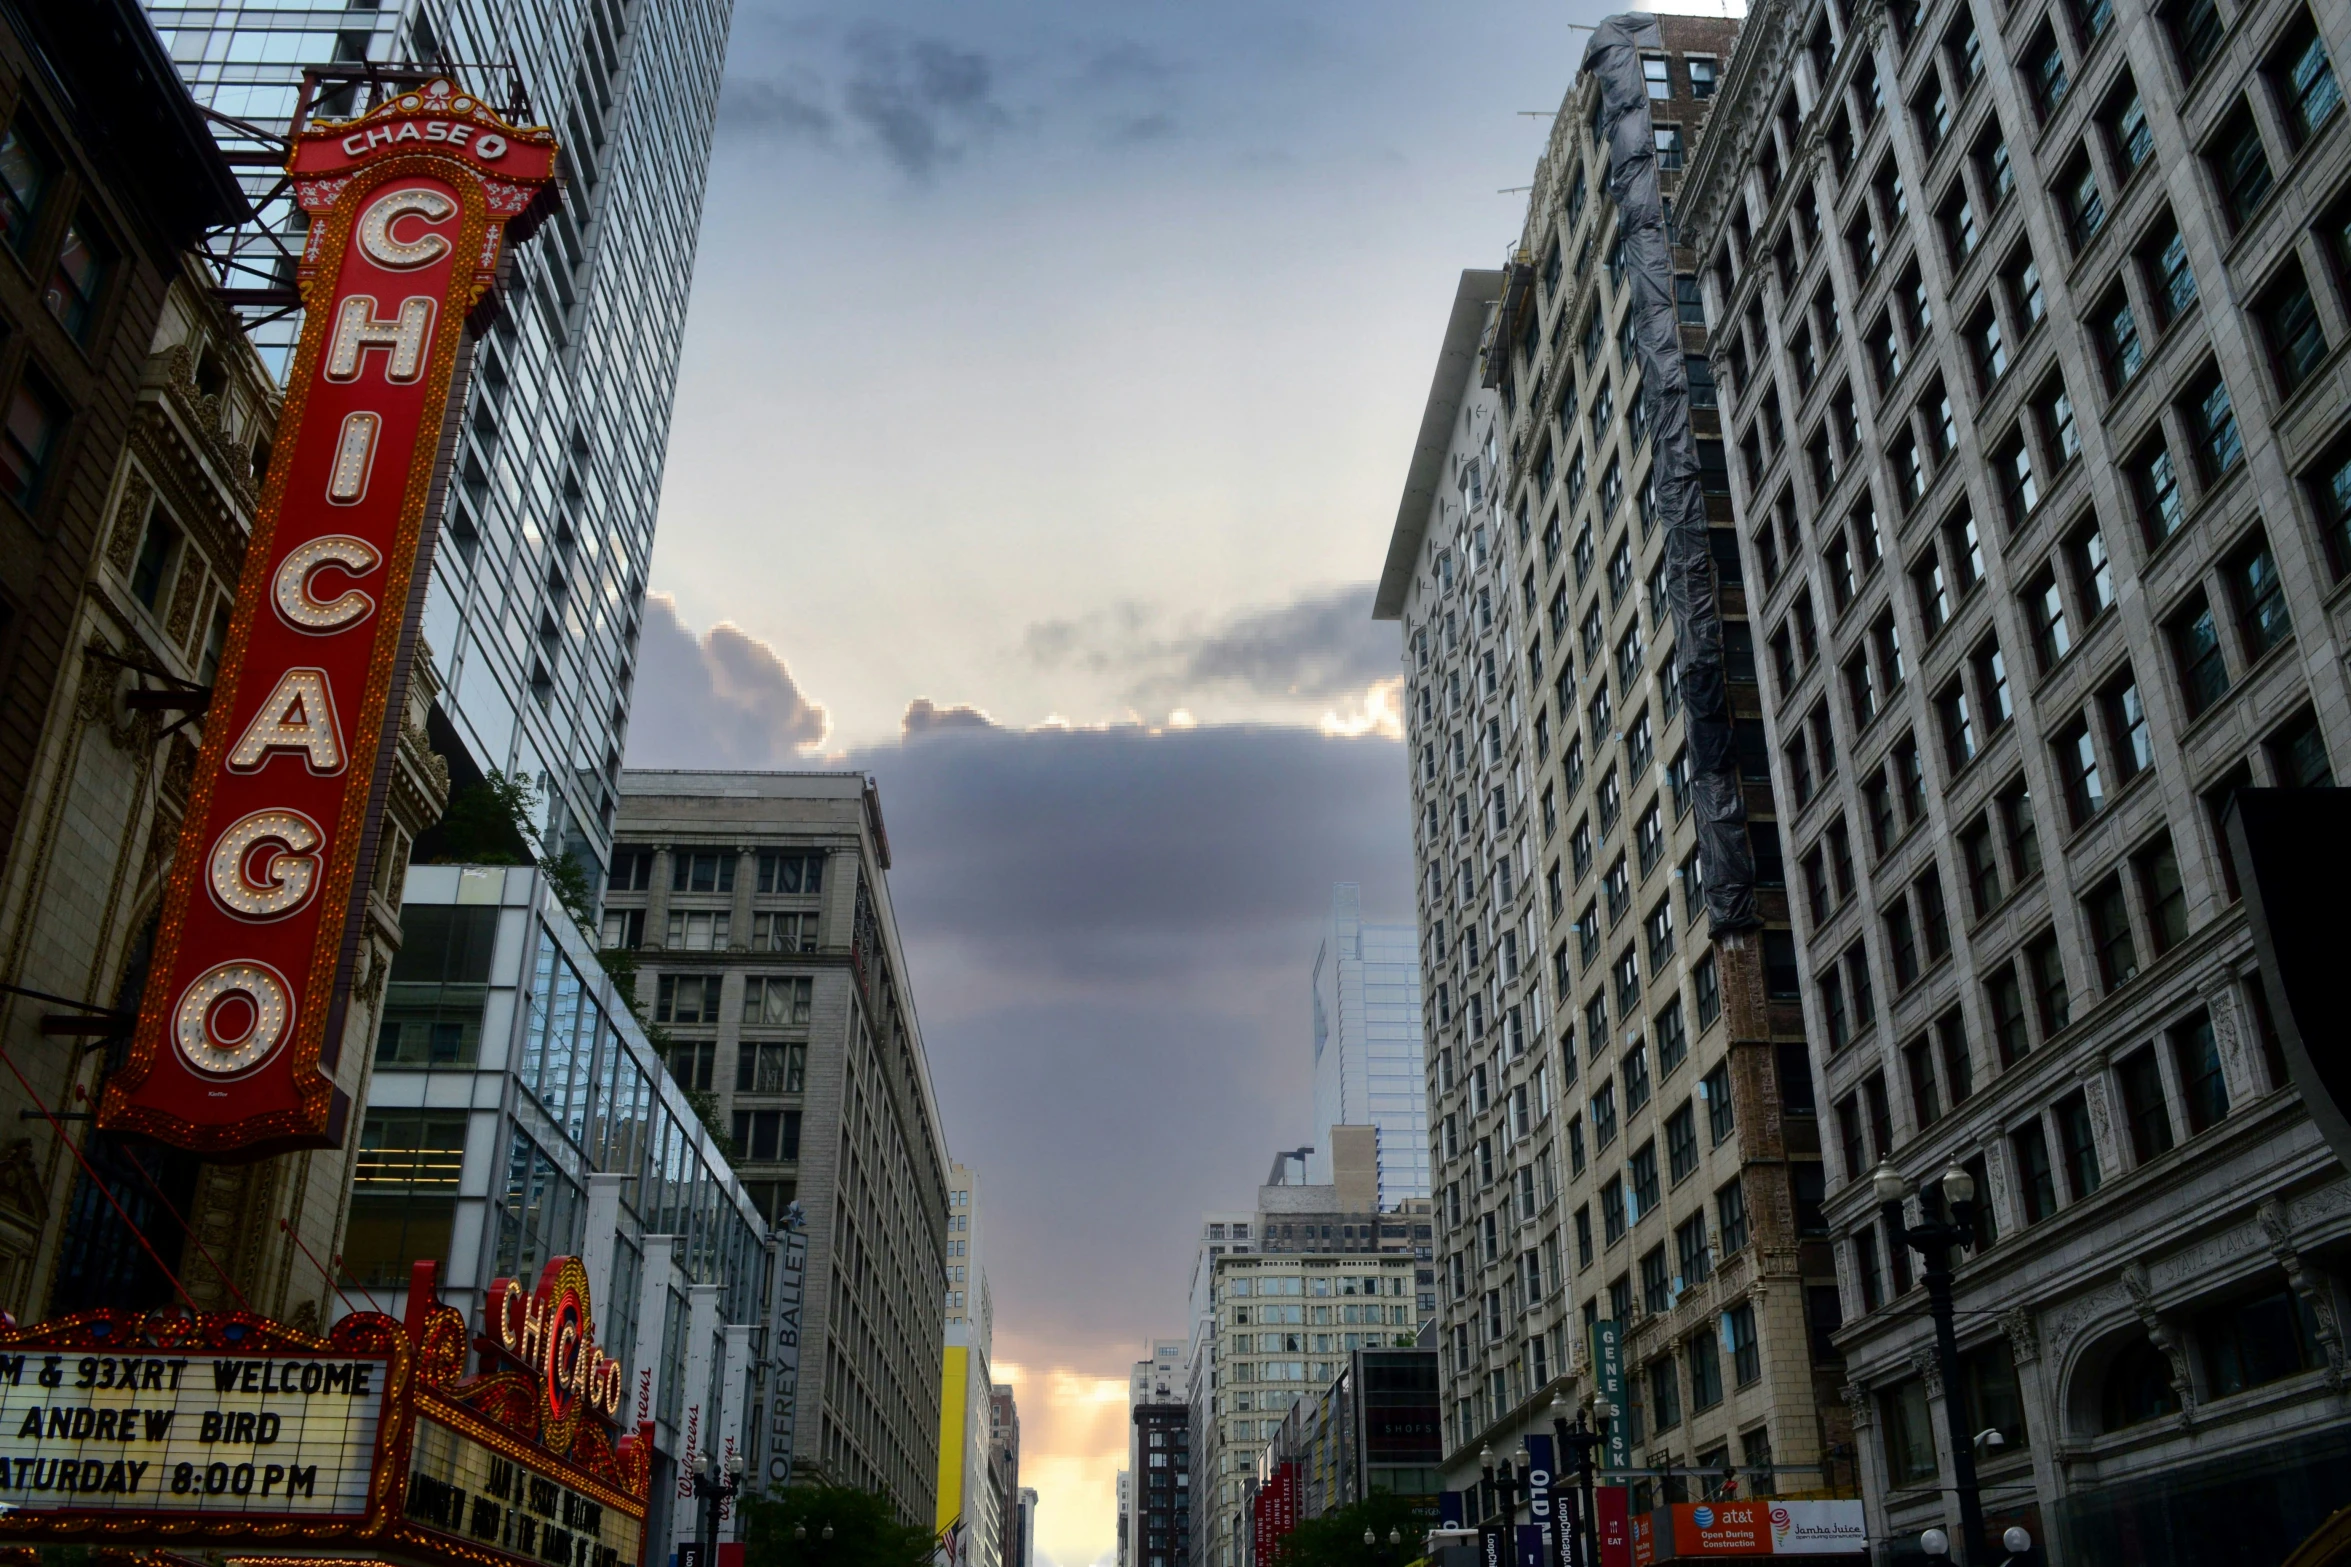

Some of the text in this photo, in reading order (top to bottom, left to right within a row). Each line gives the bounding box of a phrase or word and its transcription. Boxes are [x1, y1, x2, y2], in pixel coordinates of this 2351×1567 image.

[341, 120, 475, 158] CHASE
[170, 188, 458, 1083] CHICAGO
[501, 1275, 622, 1417] CHICAGO
[768, 1234, 805, 1482] OFFREY BALLET
[1602, 1331, 1618, 1392] GENE
[39, 1355, 63, 1389] &
[75, 1356, 188, 1391] 93XRT
[213, 1359, 374, 1396] WELCOME
[18, 1405, 281, 1445] ANDREW BIRD
[678, 1404, 699, 1499] Walgreens
[717, 1435, 734, 1521] Wagreens
[1283, 1478, 1291, 1502] STATE
[1530, 1469, 1551, 1517] OLD
[1701, 1529, 1754, 1541] Open During
[1722, 1508, 1754, 1524] at&t
[1607, 1537, 1623, 1546] EAT
[1703, 1538, 1756, 1548] Construction
